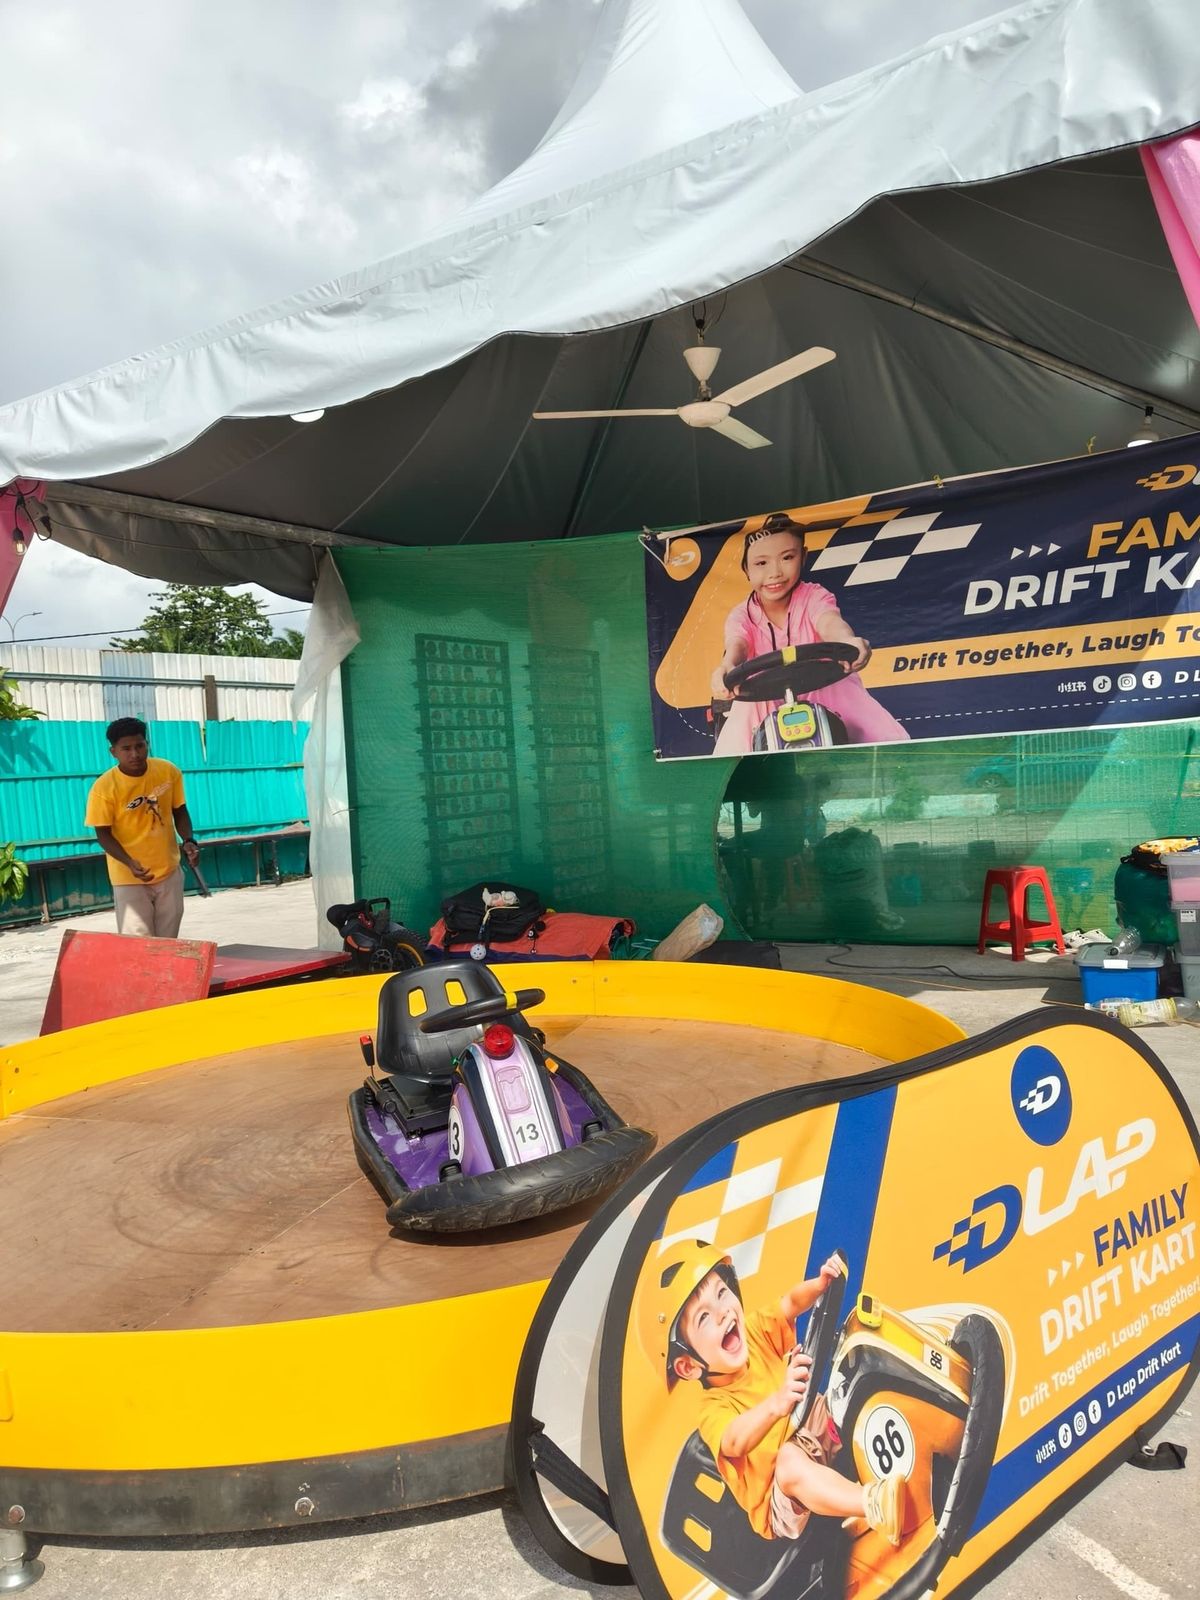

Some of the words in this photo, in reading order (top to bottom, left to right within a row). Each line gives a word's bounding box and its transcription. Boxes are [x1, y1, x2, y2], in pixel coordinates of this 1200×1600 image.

[1087, 511, 1200, 558] FAM
[964, 560, 1130, 615] DRIFT
[893, 652, 947, 672] Drift
[956, 641, 1073, 666] Together,
[1082, 628, 1165, 653] Laugh
[1174, 670, 1190, 684] D
[516, 1123, 539, 1143] 13
[1093, 1182, 1188, 1267] FAMILY
[1040, 1265, 1124, 1356] DRIFT
[1130, 1222, 1197, 1293] KART
[930, 1349, 943, 1371] 86
[1019, 1381, 1050, 1417] Drift
[1052, 1341, 1111, 1392] Together,
[1112, 1311, 1149, 1349] Laugh
[1107, 1391, 1116, 1408] D
[1117, 1377, 1137, 1399] Lap
[1137, 1359, 1160, 1384] Drift
[1160, 1341, 1182, 1367] Kart
[872, 1419, 905, 1474] 86
